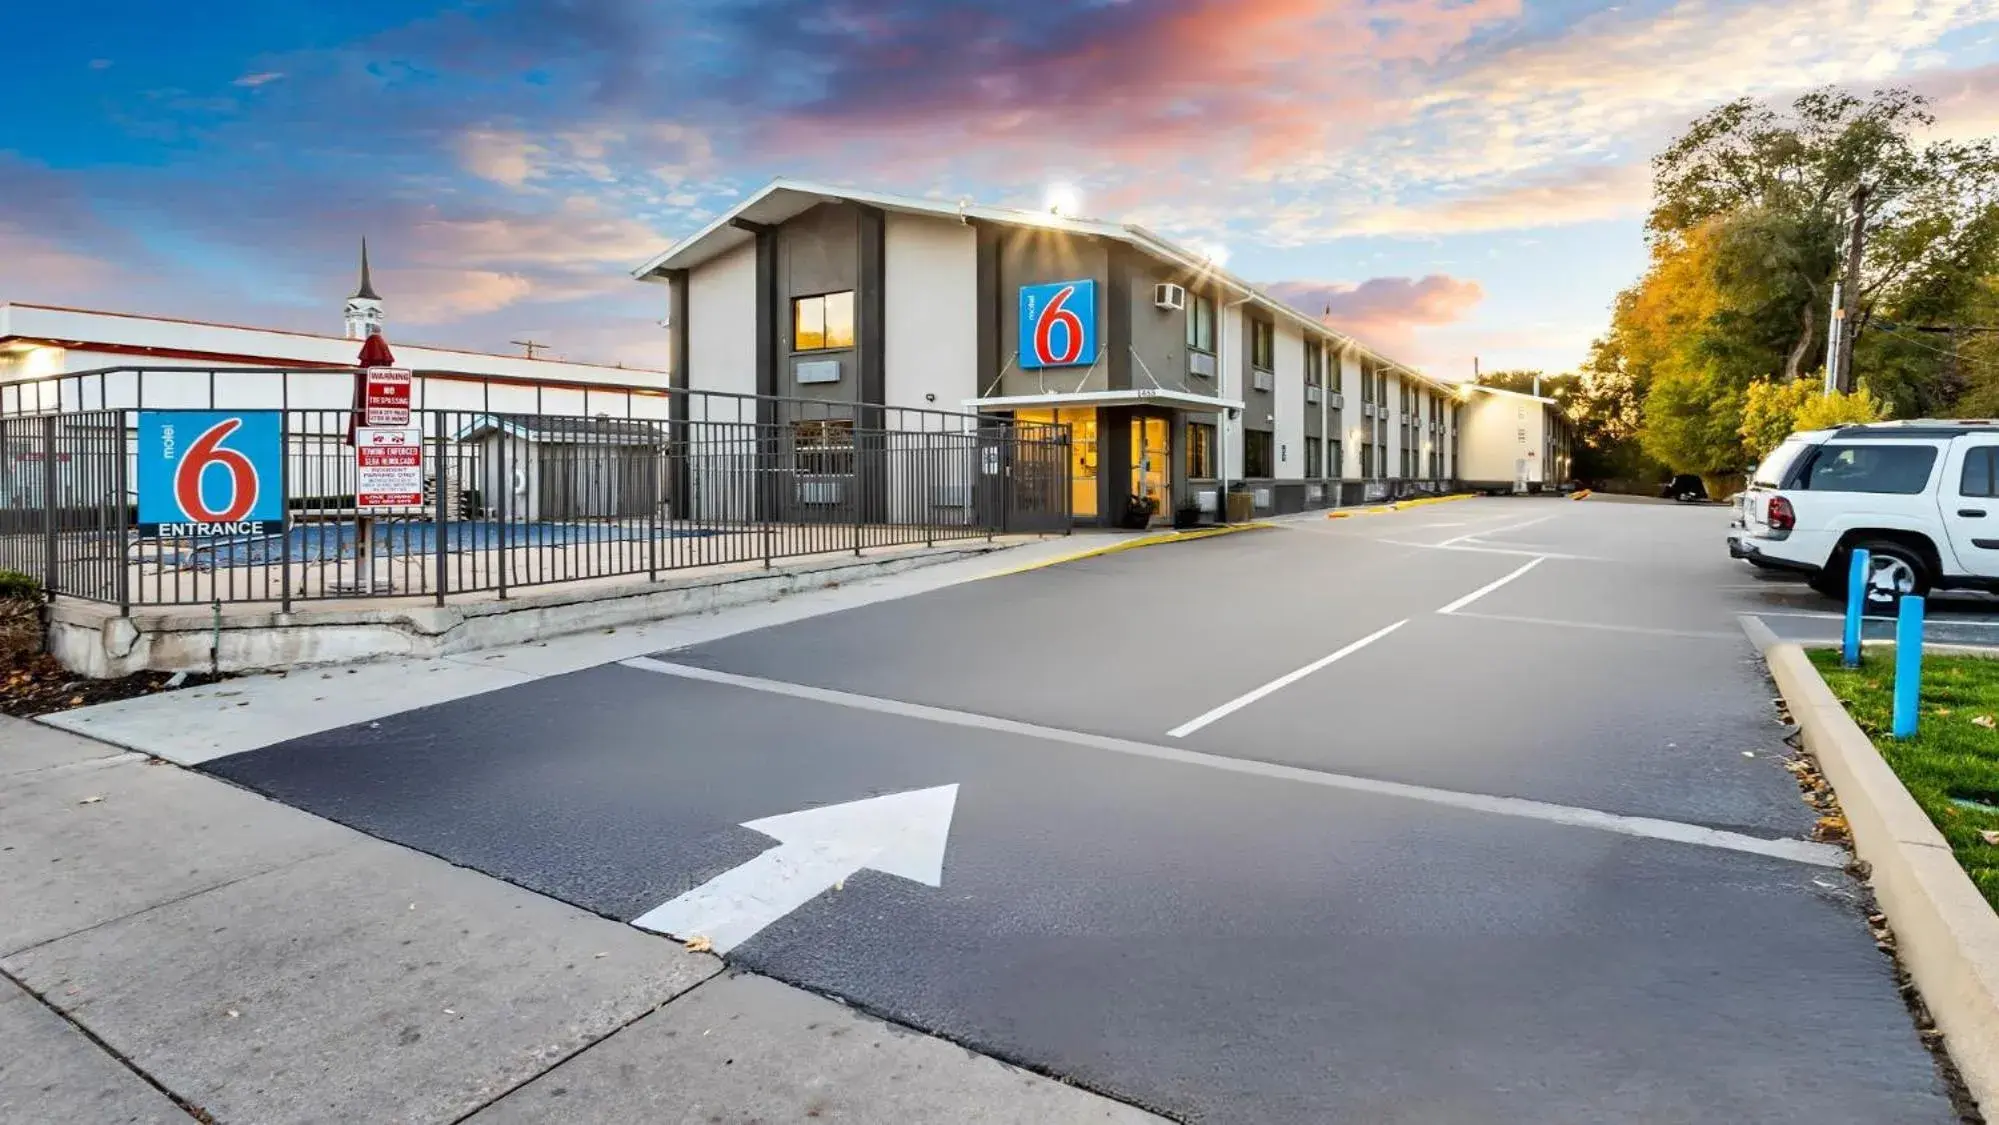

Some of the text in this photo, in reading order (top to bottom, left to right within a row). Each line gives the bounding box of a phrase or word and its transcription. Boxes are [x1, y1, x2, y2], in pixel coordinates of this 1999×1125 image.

[1027, 295, 1035, 321] motel
[1034, 286, 1084, 365] 6
[371, 372, 409, 380] WARNING
[383, 386, 395, 395] NO
[370, 396, 409, 405] TRESPASSING
[162, 424, 174, 459] motel
[387, 447, 418, 455] ENFORCED
[173, 417, 259, 523] 6
[158, 521, 264, 537] ENTRANCE
